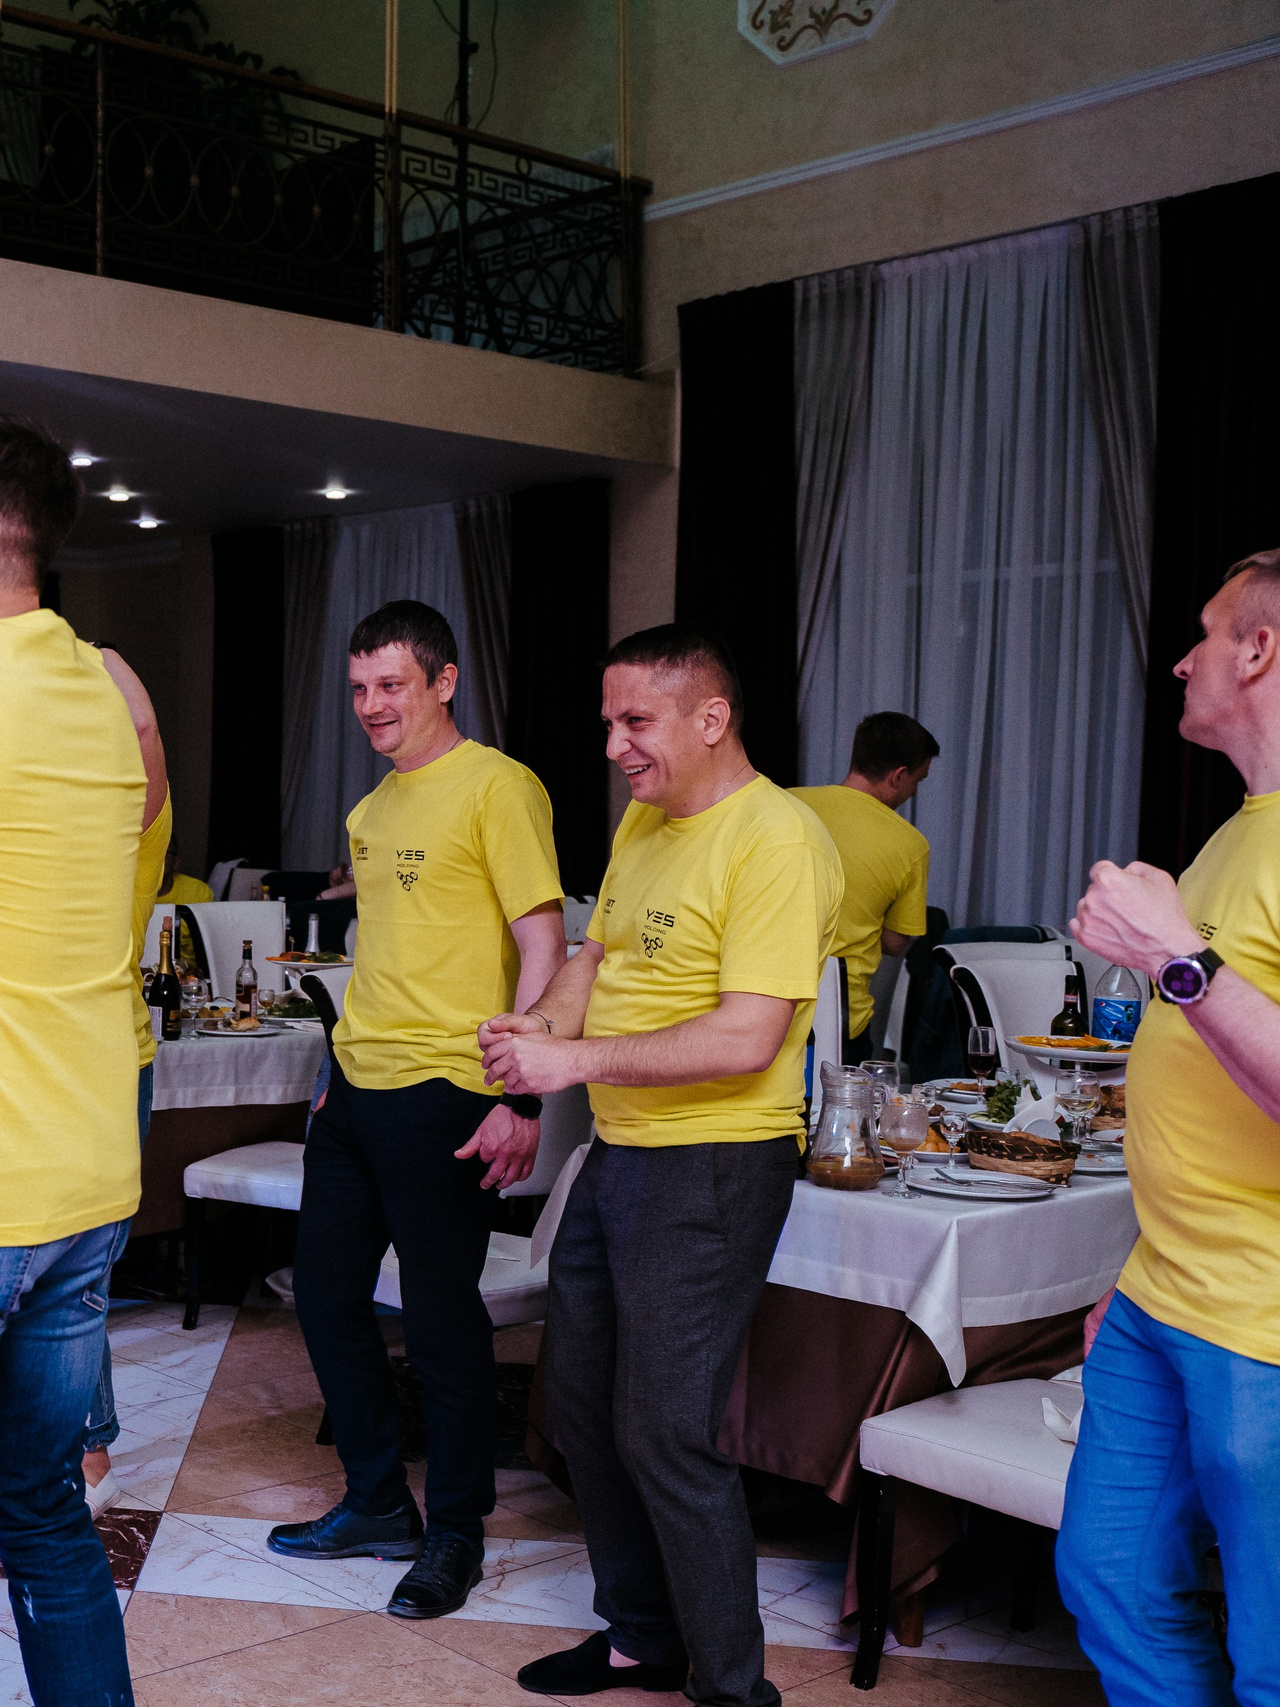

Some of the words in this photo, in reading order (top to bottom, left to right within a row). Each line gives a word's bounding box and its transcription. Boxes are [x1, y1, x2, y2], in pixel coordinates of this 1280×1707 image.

[396, 849, 425, 861] YES
[646, 908, 675, 928] YES
[1196, 922, 1217, 941] ES
